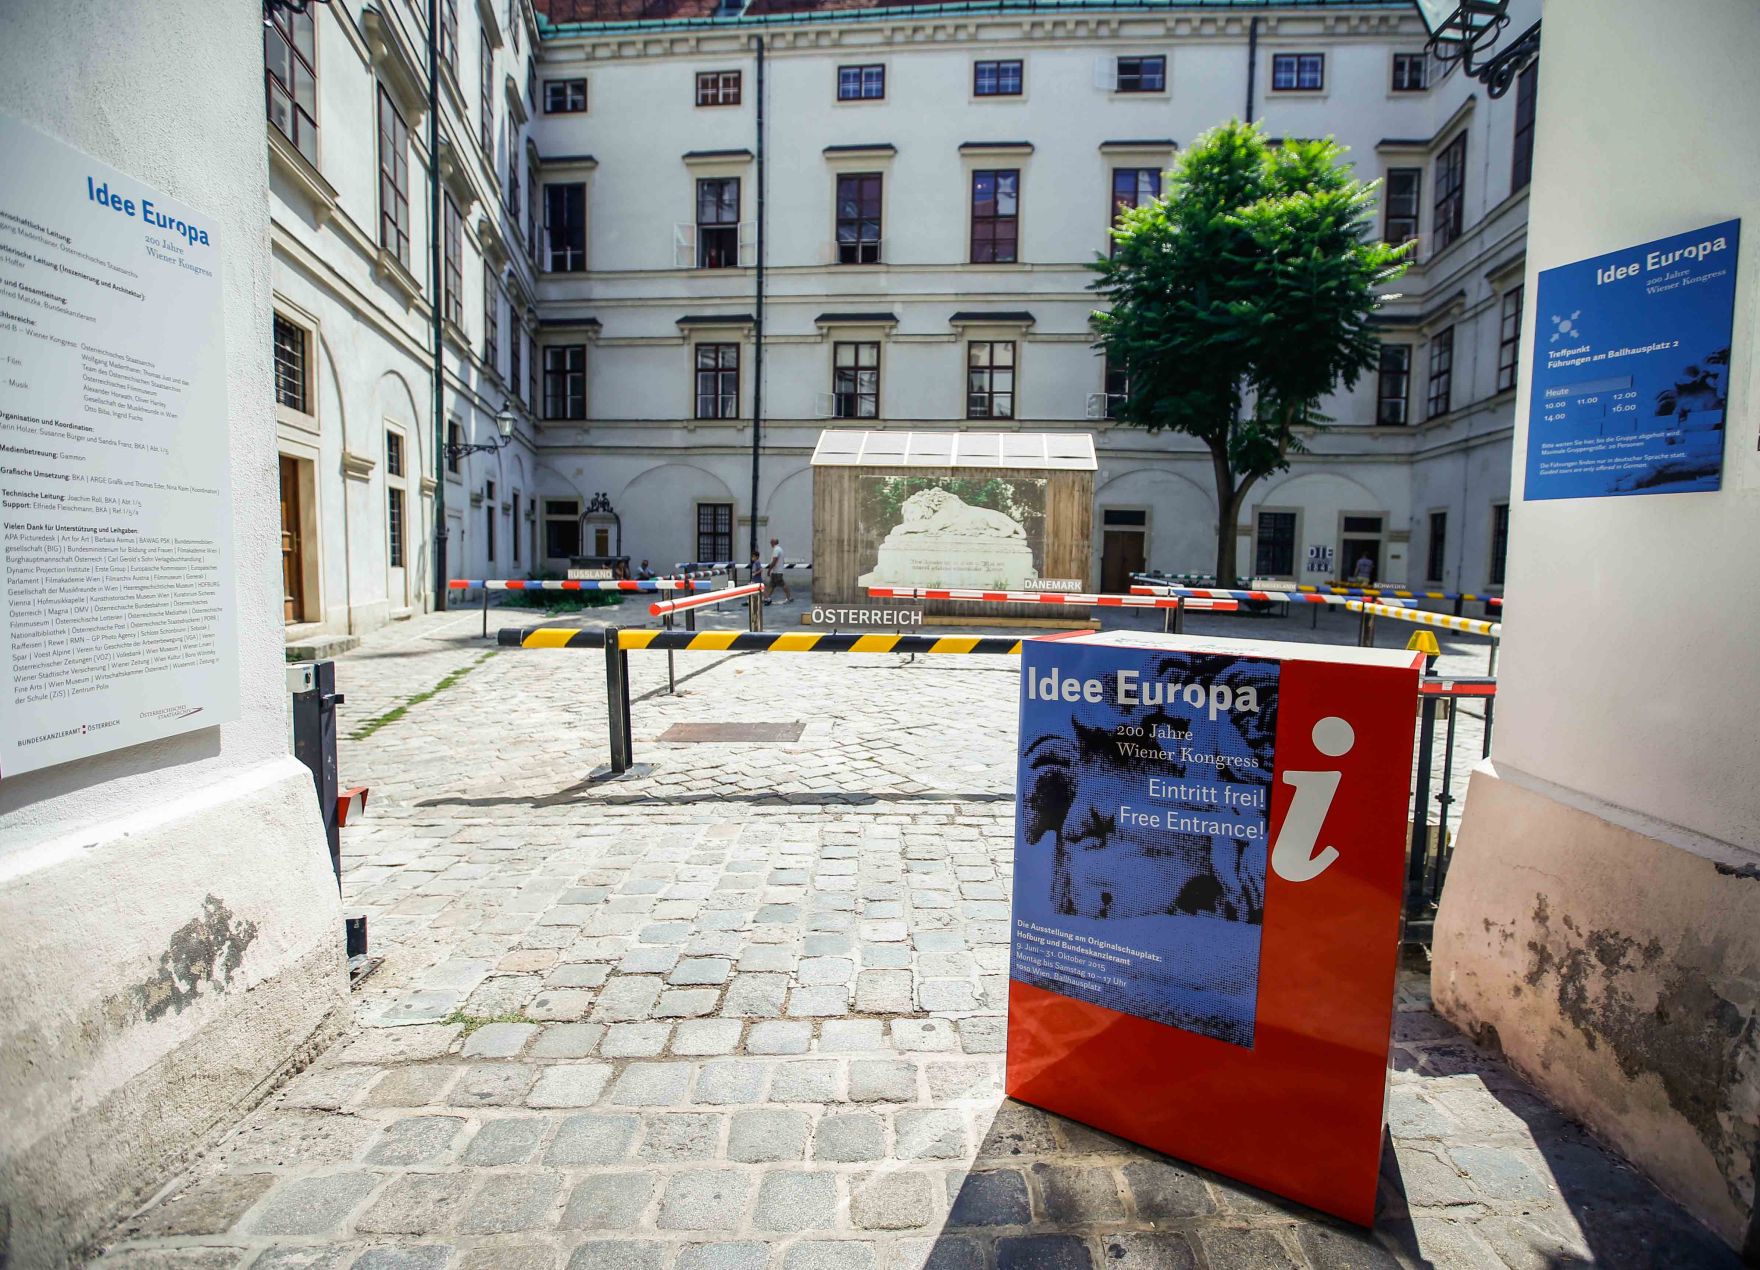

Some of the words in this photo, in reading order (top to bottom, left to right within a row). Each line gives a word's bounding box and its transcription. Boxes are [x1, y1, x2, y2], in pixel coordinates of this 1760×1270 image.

[88, 175, 136, 217] Idee
[142, 199, 210, 247] Europa
[145, 235, 160, 247] 200
[162, 239, 184, 255] Jahre
[146, 246, 176, 264] Wiener
[178, 258, 213, 277] Kongress
[1597, 263, 1640, 285] Idee
[1646, 237, 1727, 271] Europa
[4, 278, 17, 288] und
[1647, 277, 1663, 286] 200
[1664, 269, 1690, 281] Jahre
[1647, 282, 1680, 294] Wiener
[1682, 270, 1727, 286] Kongress
[1548, 355, 1591, 368] Führungen
[1607, 342, 1670, 359] Ballhausplatz
[1549, 345, 1590, 359] Treffpunkt
[1546, 388, 1569, 397] Heute
[1613, 392, 1637, 400] 12.00
[1613, 404, 1636, 412] 16.00
[41, 418, 53, 426] und
[1544, 413, 1565, 422] 14.00
[1644, 454, 1669, 462] Sprache
[0, 467, 32, 477] Grafische
[90, 475, 107, 484] ARGE
[2, 489, 39, 498] Technische
[2, 500, 31, 510] Support:
[4, 522, 25, 530] Vielen
[55, 525, 98, 535] Unterstützung
[5, 546, 43, 554] gesellschaft
[44, 546, 62, 554] (BIG)
[6, 556, 74, 565] Burghauptmannschaft
[6, 566, 35, 575] Dynamic
[36, 566, 66, 575] Projection
[568, 570, 612, 579] RUSSLAND
[7, 577, 40, 586] Parlament
[45, 576, 85, 584] Filmakademie
[8, 587, 47, 597] Gesellschaft
[48, 587, 58, 595] der
[9, 599, 31, 607] Vienna
[48, 608, 69, 618] Magna
[811, 606, 922, 625] ÖSTERREICH
[10, 619, 50, 629] Filmmuseum
[11, 629, 67, 640] Nationalbibliothek
[11, 642, 42, 651] Raiffeisen
[48, 639, 65, 647] Rewe
[70, 636, 85, 644] RMN
[91, 634, 101, 642] GP
[101, 633, 118, 641] Photo
[118, 632, 136, 641] Agency
[12, 654, 28, 663] Spar
[33, 650, 52, 659] Voest
[52, 648, 72, 657] Alpine
[64, 656, 92, 667] Zeitungen
[13, 673, 37, 683] Wiener
[70, 664, 107, 675] Versicherung
[14, 685, 29, 694] Fine
[29, 684, 43, 692] Arts
[48, 680, 65, 689] Wien
[65, 677, 90, 686] Museum
[1028, 666, 1103, 703] Idee
[1117, 669, 1260, 721] Europa
[15, 696, 26, 705] der
[26, 693, 49, 703] Schule
[50, 689, 66, 701] (ZiS)
[71, 686, 96, 696] Zentrum
[17, 725, 81, 748] BUNDESKANZLERAMT
[1117, 725, 1144, 738] 200
[1149, 722, 1193, 742] Jahre
[1117, 741, 1175, 762] Wiener
[1180, 746, 1259, 770] Kongress
[1149, 779, 1218, 805] Eintritt
[1224, 784, 1266, 809] frei!
[1120, 805, 1160, 829] Free
[1167, 810, 1266, 841] Entrance!
[1016, 930, 1045, 946] Hofburg
[1046, 939, 1060, 948] und
[1061, 941, 1131, 966] Bundeskanzleramt
[1017, 919, 1029, 929] Die
[1030, 923, 1073, 943] Ausstellung
[1074, 934, 1086, 943] am
[1087, 936, 1162, 963] Originalschauplatz:
[1024, 944, 1039, 954] Juni
[1057, 952, 1086, 966] Oktober
[1088, 961, 1106, 973] 2015
[1016, 950, 1042, 967] Montag
[1043, 959, 1054, 969] bis
[1054, 962, 1086, 979] Samstag
[1087, 972, 1096, 980] 10
[1113, 977, 1129, 989] Uhr
[1054, 972, 1101, 992] Ballhausplatz
